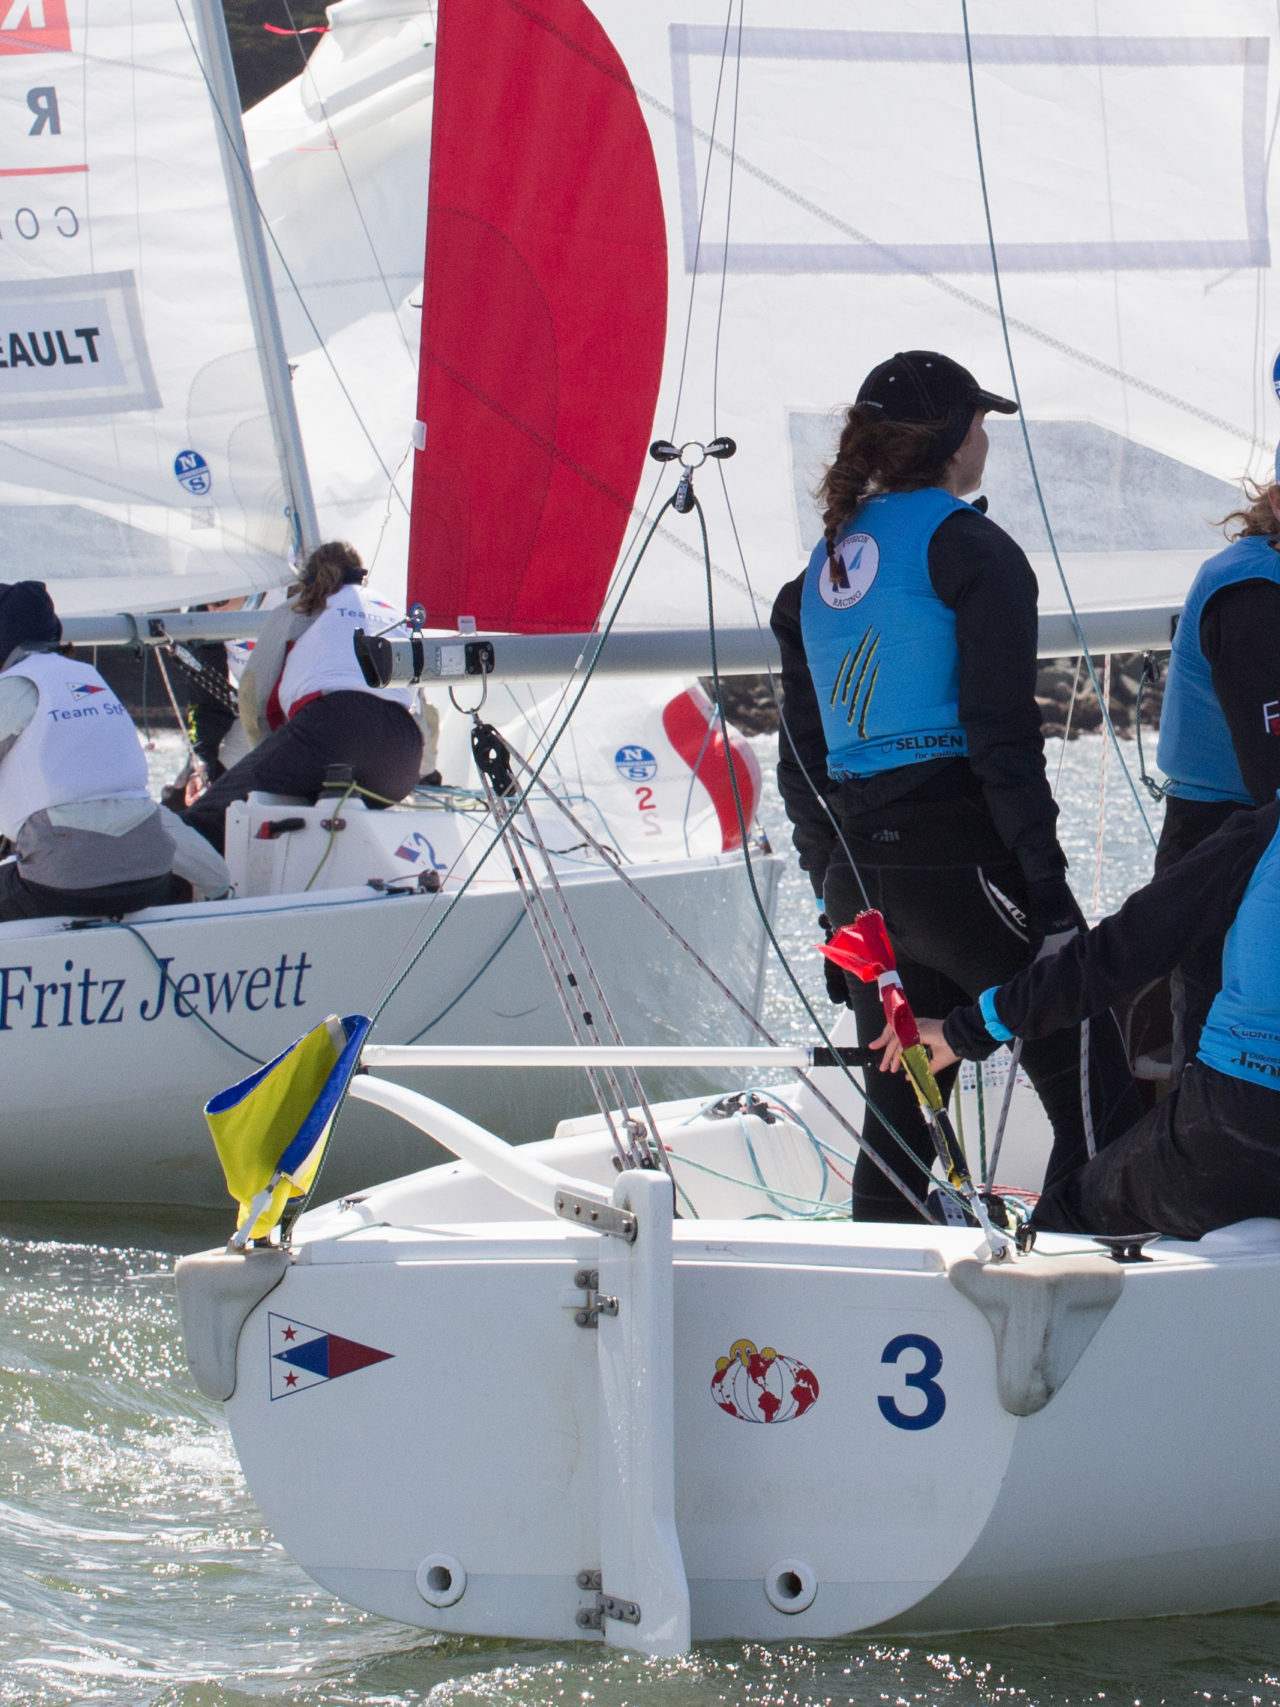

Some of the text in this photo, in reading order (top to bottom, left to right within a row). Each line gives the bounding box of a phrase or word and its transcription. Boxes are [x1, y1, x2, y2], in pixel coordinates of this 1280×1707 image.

[832, 590, 862, 608] RACING
[48, 703, 99, 722] Team
[896, 733, 964, 751] SELDÉN
[635, 787, 656, 812] 2
[413, 832, 448, 870] 2
[0, 952, 312, 1031] Fritz Jewett
[877, 1333, 946, 1431] 3
